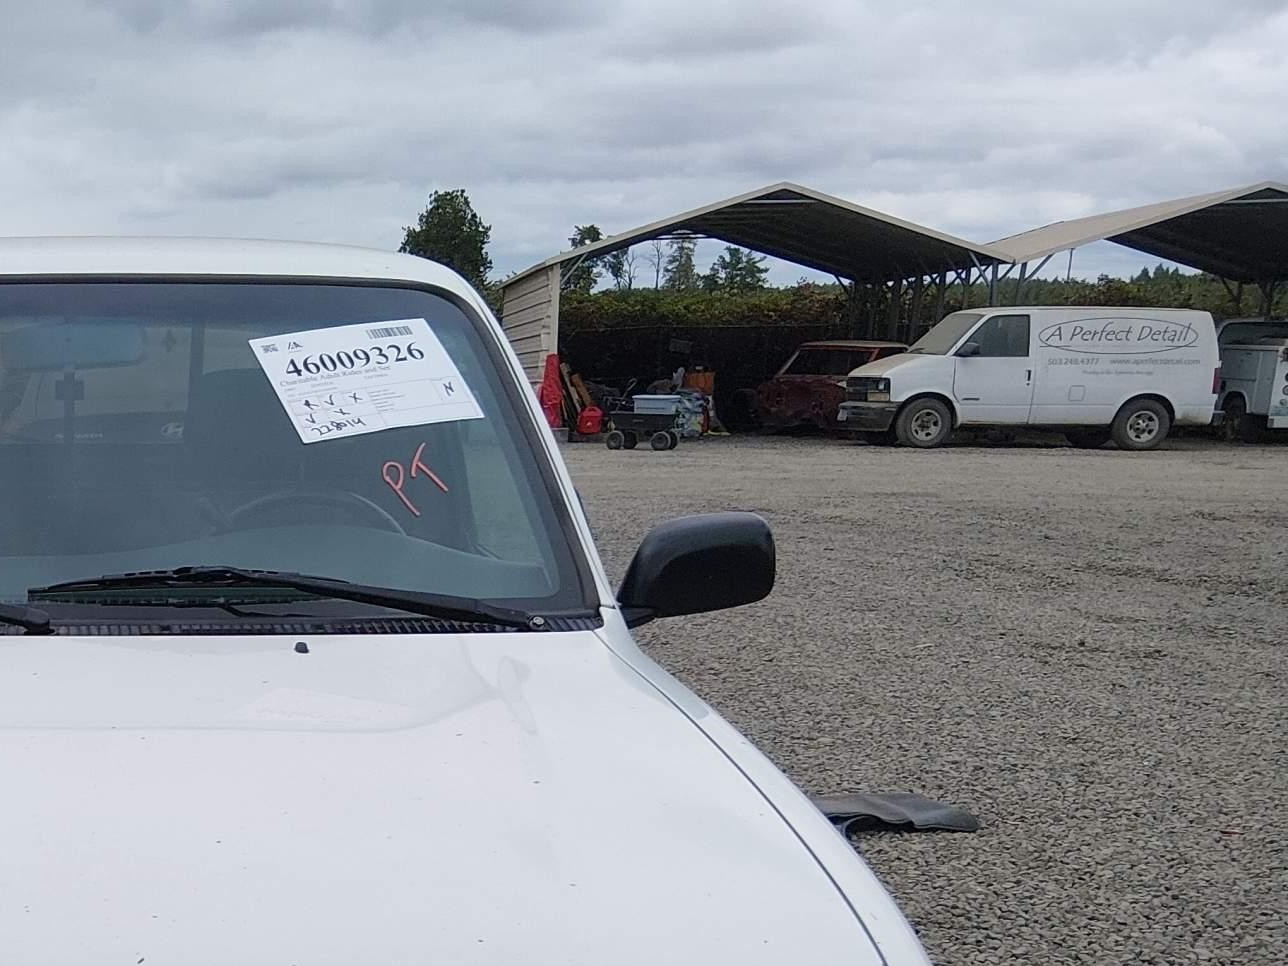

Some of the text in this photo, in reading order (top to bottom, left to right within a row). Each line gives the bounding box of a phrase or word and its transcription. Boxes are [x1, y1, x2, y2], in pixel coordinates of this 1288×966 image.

[1045, 321, 1192, 343] A Perfect Detail
[285, 341, 425, 378] 46009326
